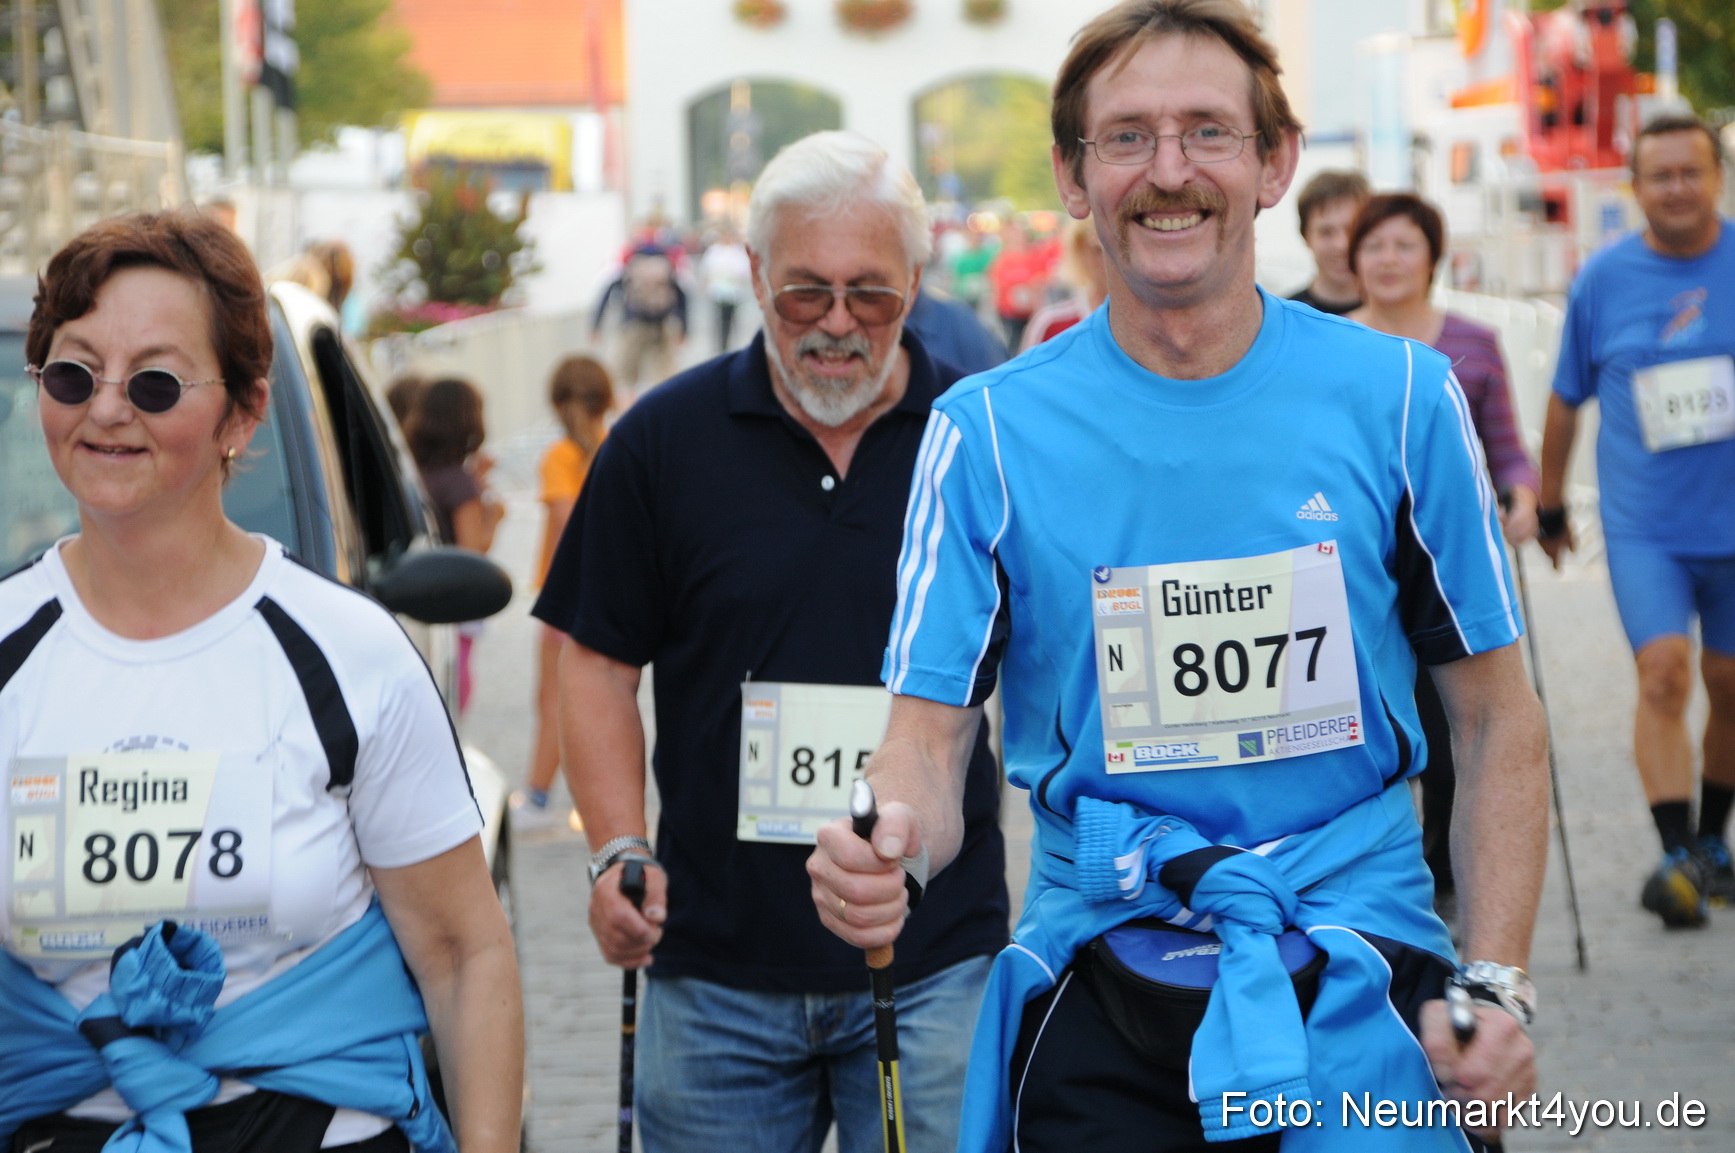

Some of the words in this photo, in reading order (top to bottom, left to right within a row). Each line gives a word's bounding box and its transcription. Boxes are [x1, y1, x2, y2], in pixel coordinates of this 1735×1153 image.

[1295, 510, 1339, 522] adidas
[1162, 579, 1273, 617] Günter
[1108, 644, 1124, 672] N
[1173, 626, 1327, 697] 8077
[1267, 715, 1357, 745] PFLEIDERER
[748, 741, 759, 763] N
[1133, 742, 1200, 760] BOCK
[790, 746, 873, 788] 815
[79, 766, 189, 814] Regina
[19, 831, 34, 860] N
[82, 829, 244, 884] 8078
